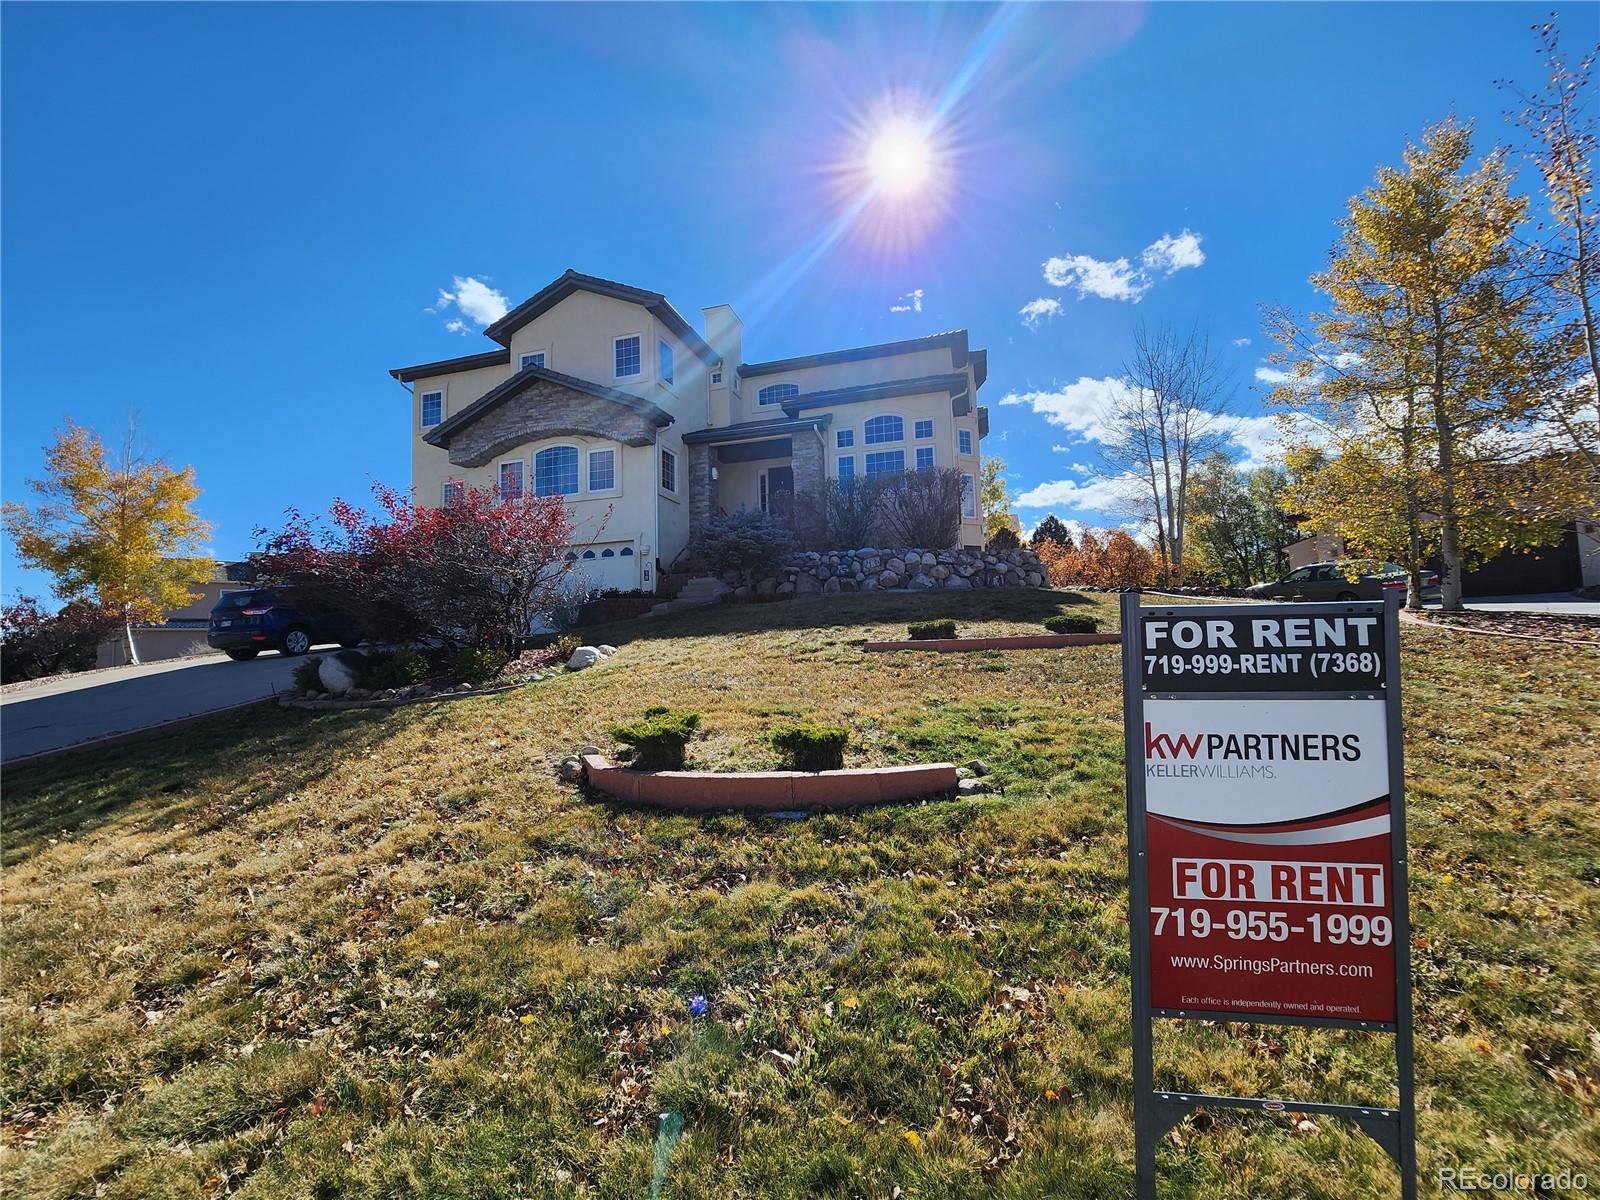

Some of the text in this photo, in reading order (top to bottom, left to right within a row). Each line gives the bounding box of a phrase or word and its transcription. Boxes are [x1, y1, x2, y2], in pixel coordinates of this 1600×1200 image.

[1145, 617, 1377, 649] FOR RENT
[1144, 652, 1381, 678] 719-999-RENT (7368)
[1176, 862, 1380, 904] FOR RENT
[1150, 907, 1393, 947] 719-955-1999
[1171, 955, 1373, 978] www.SpringsPartners.com
[1181, 995, 1200, 1005] Each
[1201, 997, 1222, 1006] office
[1231, 999, 1282, 1010] independently
[1283, 1002, 1309, 1011] owned
[1310, 1003, 1325, 1012] and
